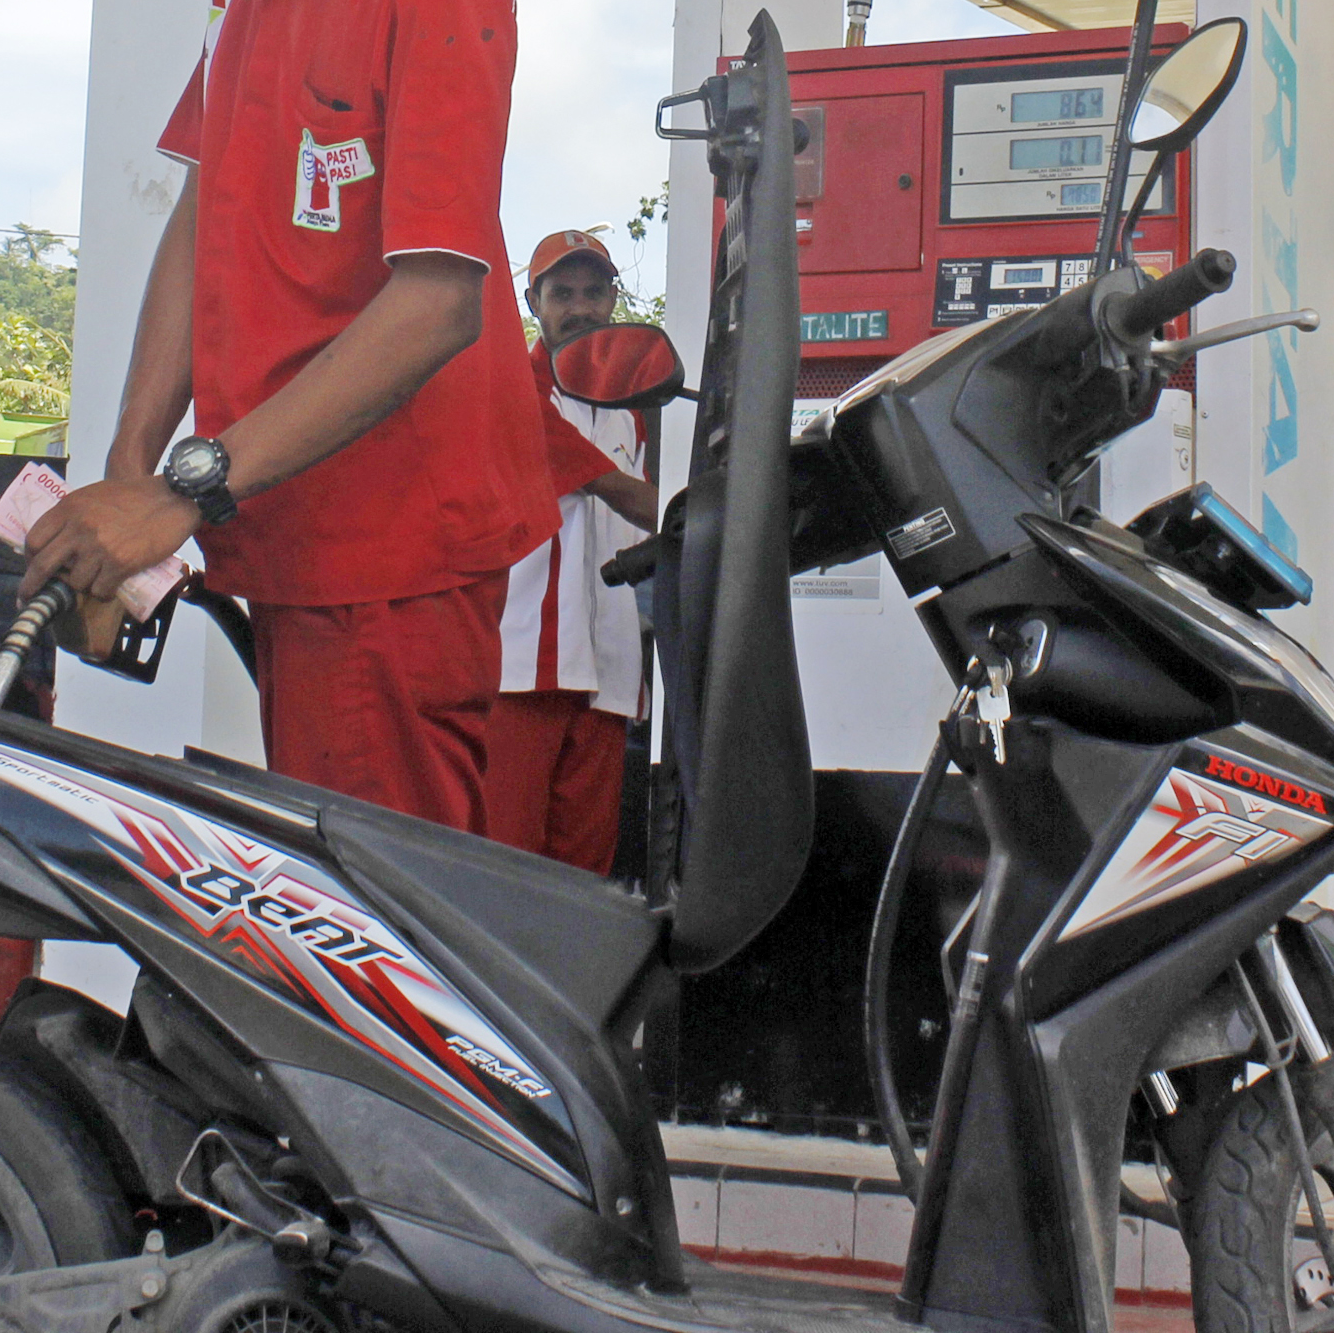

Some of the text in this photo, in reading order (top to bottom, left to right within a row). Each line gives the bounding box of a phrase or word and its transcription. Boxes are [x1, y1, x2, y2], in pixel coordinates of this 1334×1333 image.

[326, 147, 359, 167] PASTI
[1064, 277, 1071, 285] 4
[1065, 263, 1085, 272] 7 8
[803, 312, 882, 340] TALITE
[1204, 754, 1328, 815] HONDA
[1174, 811, 1290, 861] FI
[447, 1045, 536, 1098] FUEL INJECTION
